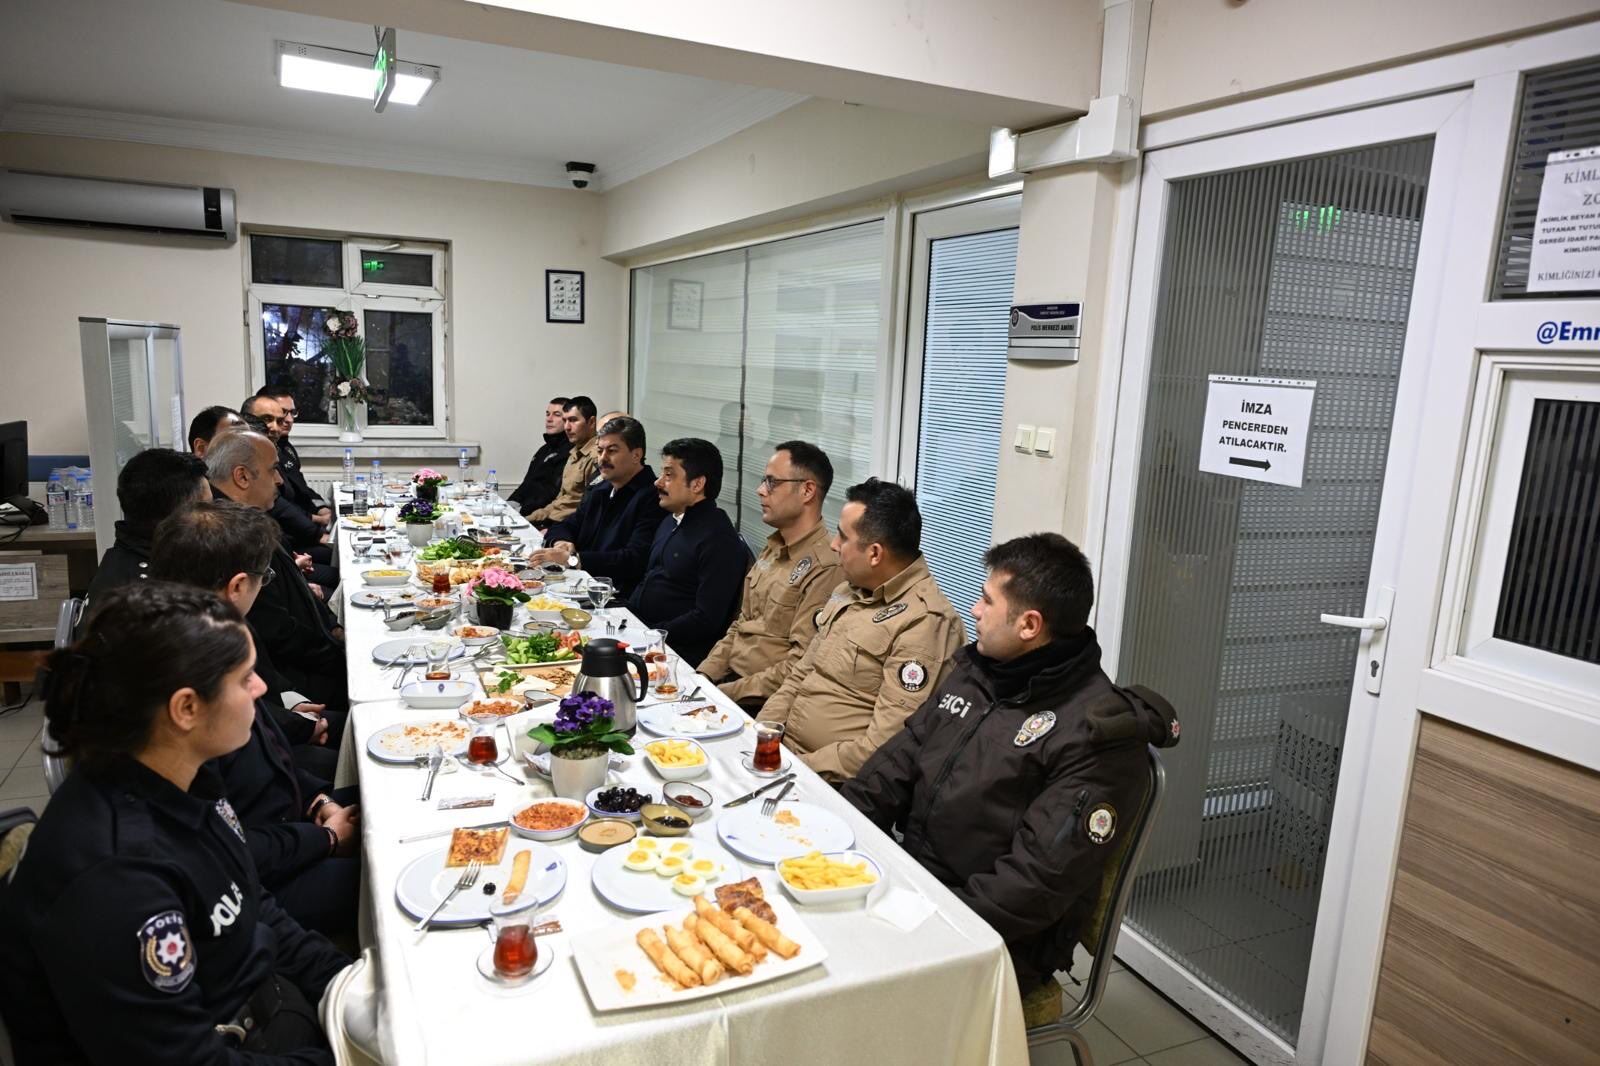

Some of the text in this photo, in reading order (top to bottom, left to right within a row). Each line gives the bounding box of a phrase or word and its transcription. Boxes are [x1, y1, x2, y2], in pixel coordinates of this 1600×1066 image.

[1241, 400, 1273, 415] İMZA
[1222, 420, 1288, 435] PENCEREDEN
[1219, 436, 1287, 452] ATILACAKTIR.
